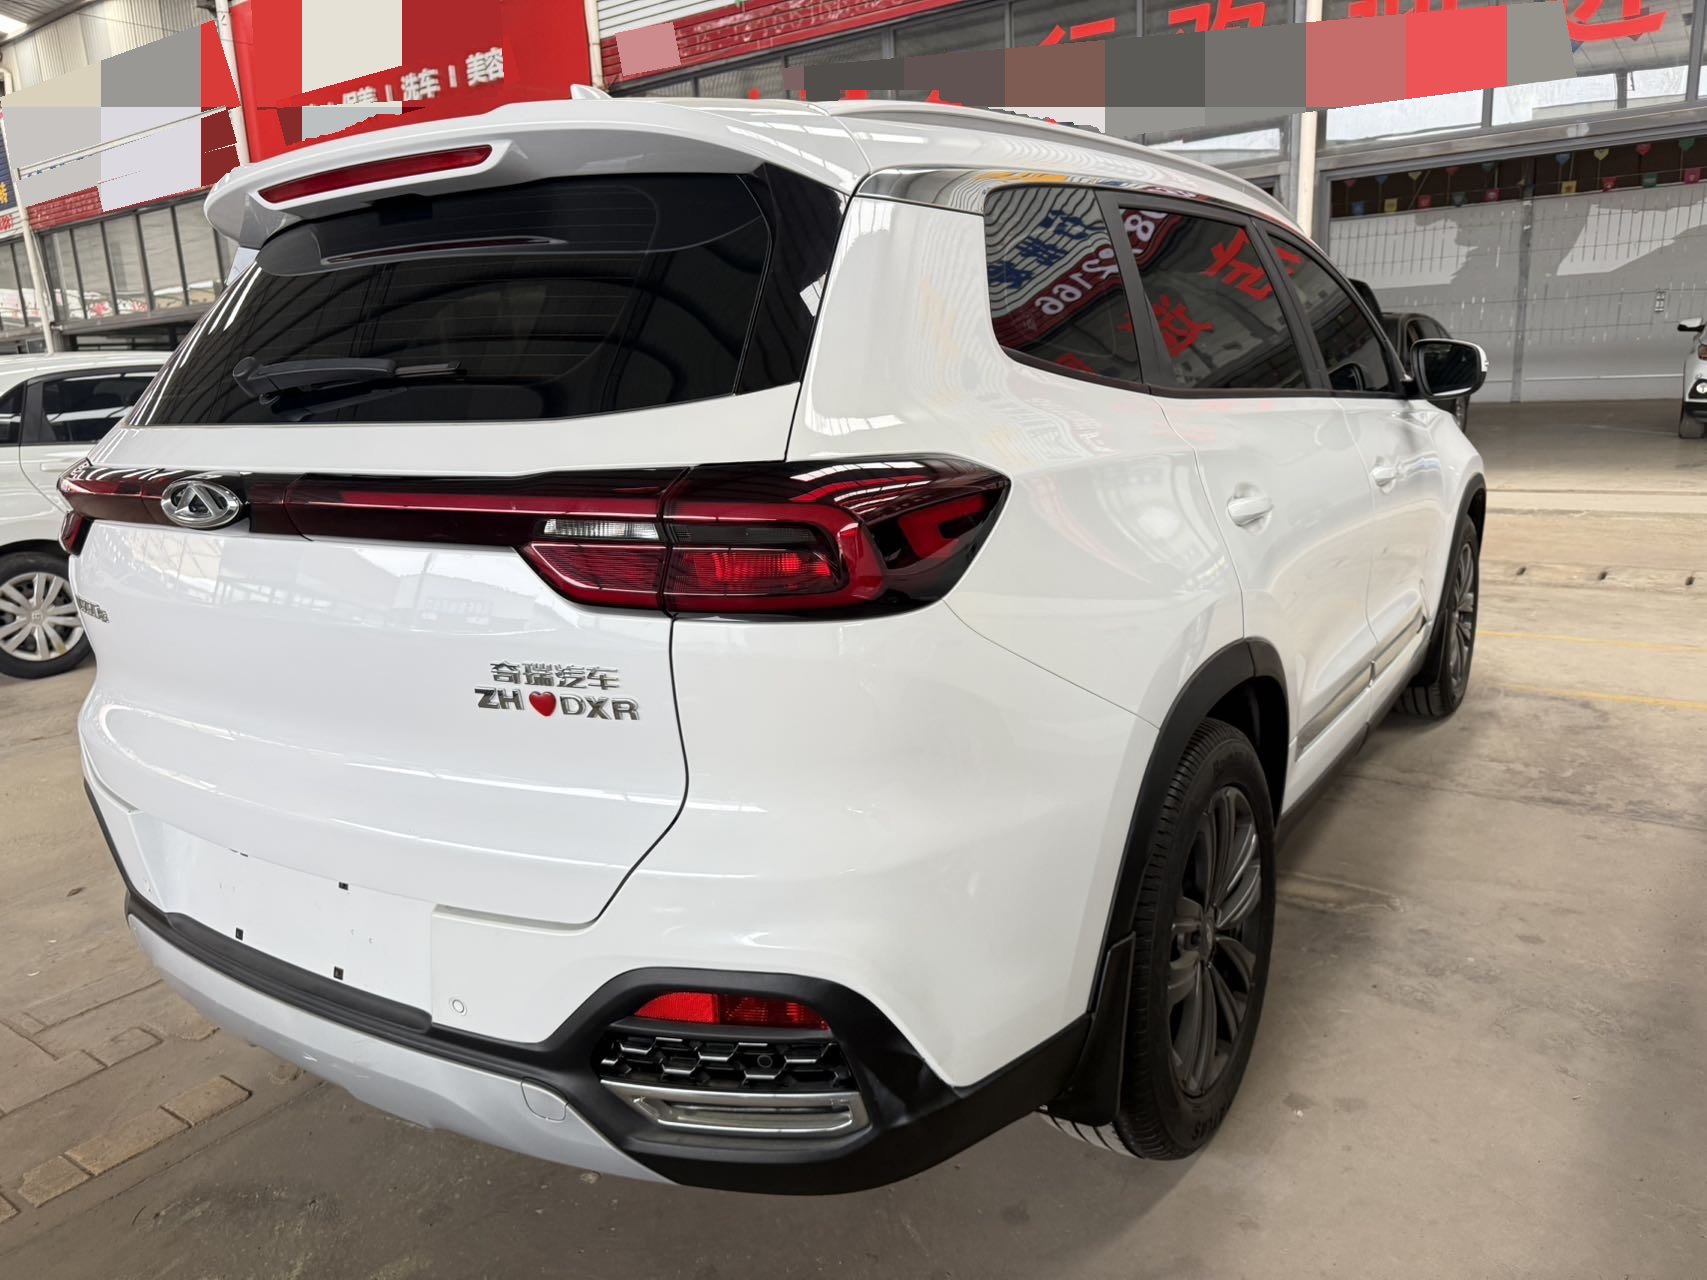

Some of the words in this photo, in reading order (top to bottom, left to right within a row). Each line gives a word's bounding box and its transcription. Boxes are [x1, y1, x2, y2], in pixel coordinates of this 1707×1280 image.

[401, 68, 441, 101] 洗车
[465, 47, 504, 87] 美容
[489, 660, 620, 690] 奇瑞汽车
[474, 687, 525, 711] ZH
[559, 692, 641, 721] DXR
